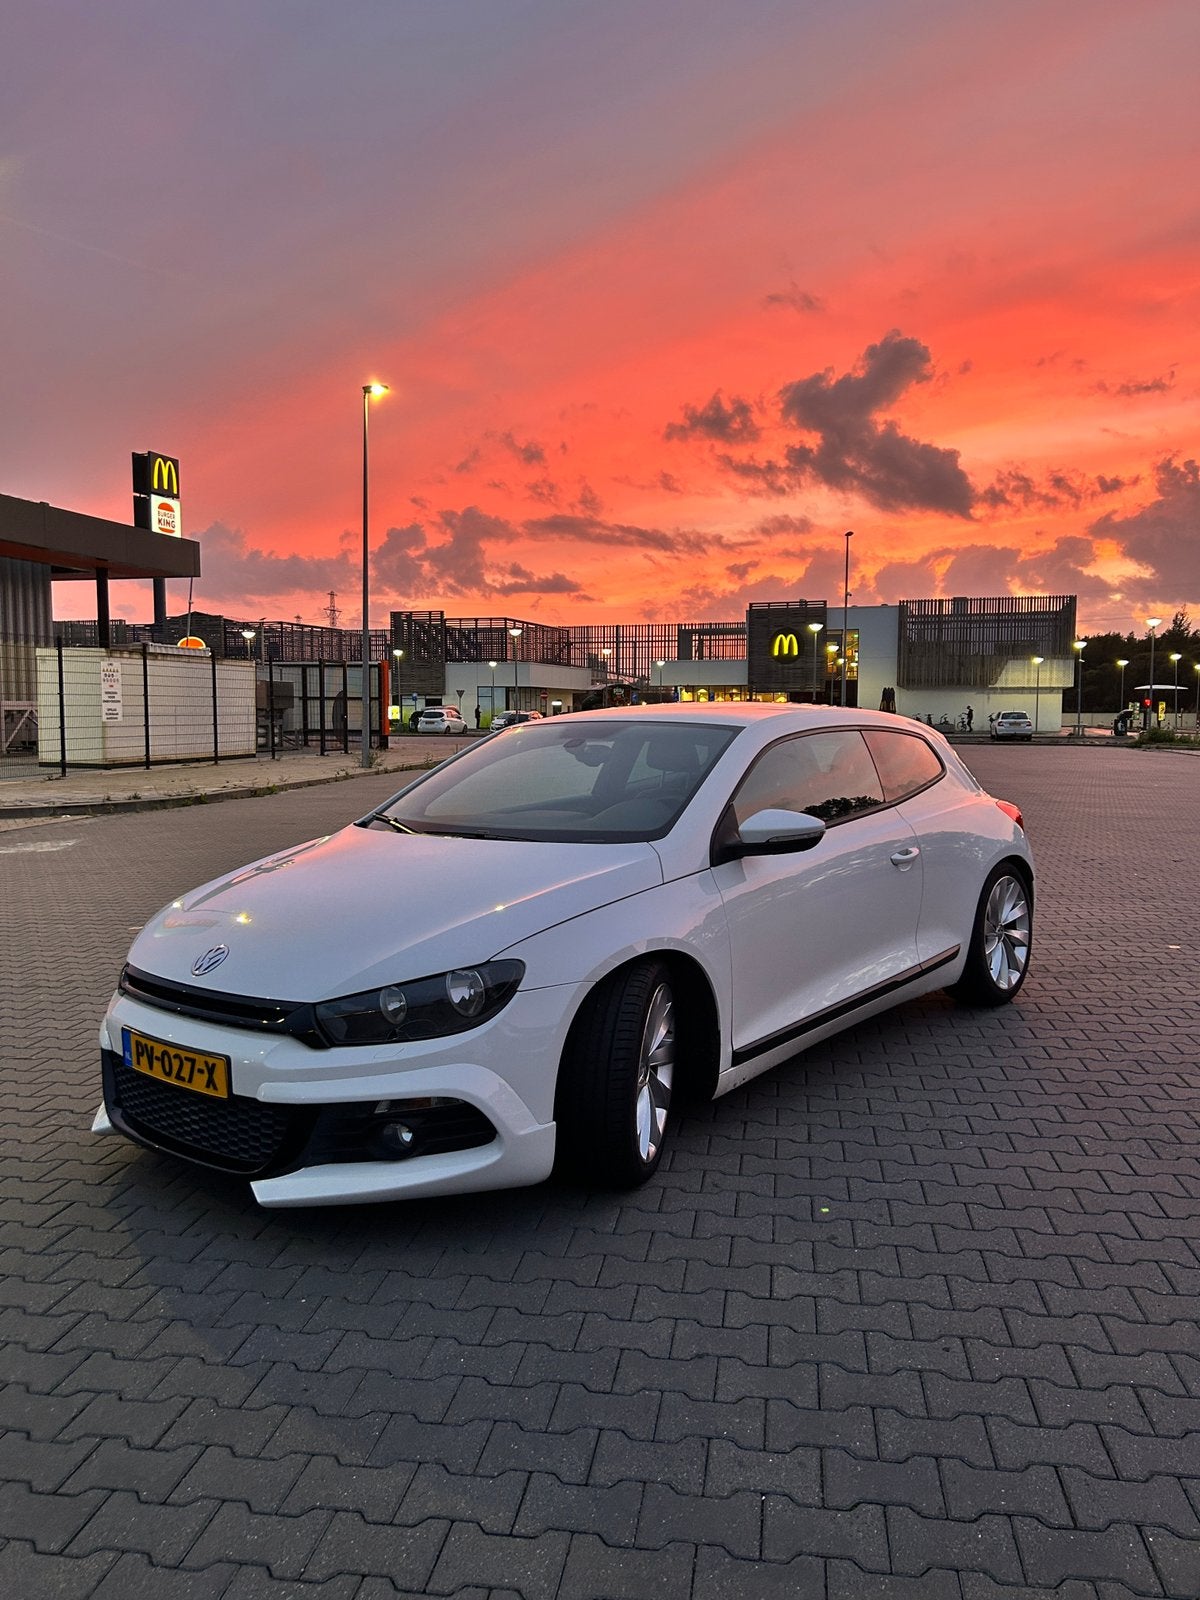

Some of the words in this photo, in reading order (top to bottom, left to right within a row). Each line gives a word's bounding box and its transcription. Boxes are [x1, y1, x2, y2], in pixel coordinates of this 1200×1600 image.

[153, 457, 178, 495] M
[157, 510, 176, 520] BURGER
[157, 517, 176, 529] KING
[773, 633, 799, 656] M
[135, 1039, 218, 1091] PV-027-X
